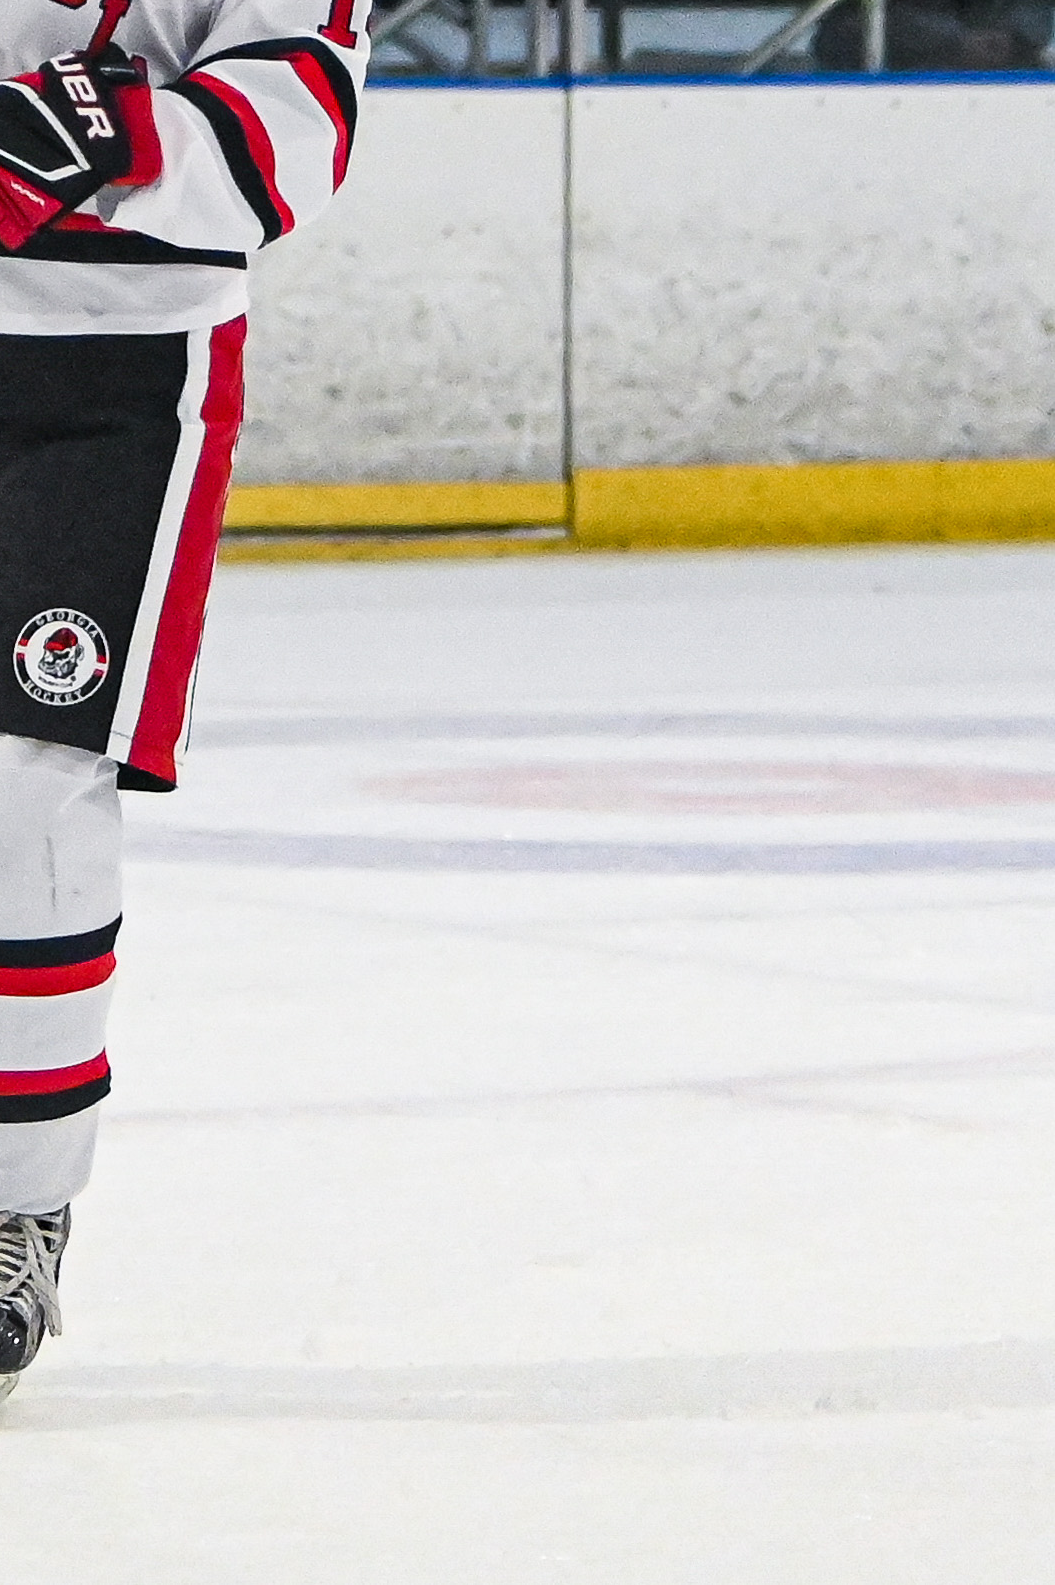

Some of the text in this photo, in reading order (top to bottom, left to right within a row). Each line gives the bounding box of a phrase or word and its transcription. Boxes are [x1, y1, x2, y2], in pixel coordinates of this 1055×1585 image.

[50, 53, 115, 139] UER
[36, 611, 98, 639] GEORGIA
[24, 679, 83, 703] HOCKEY
